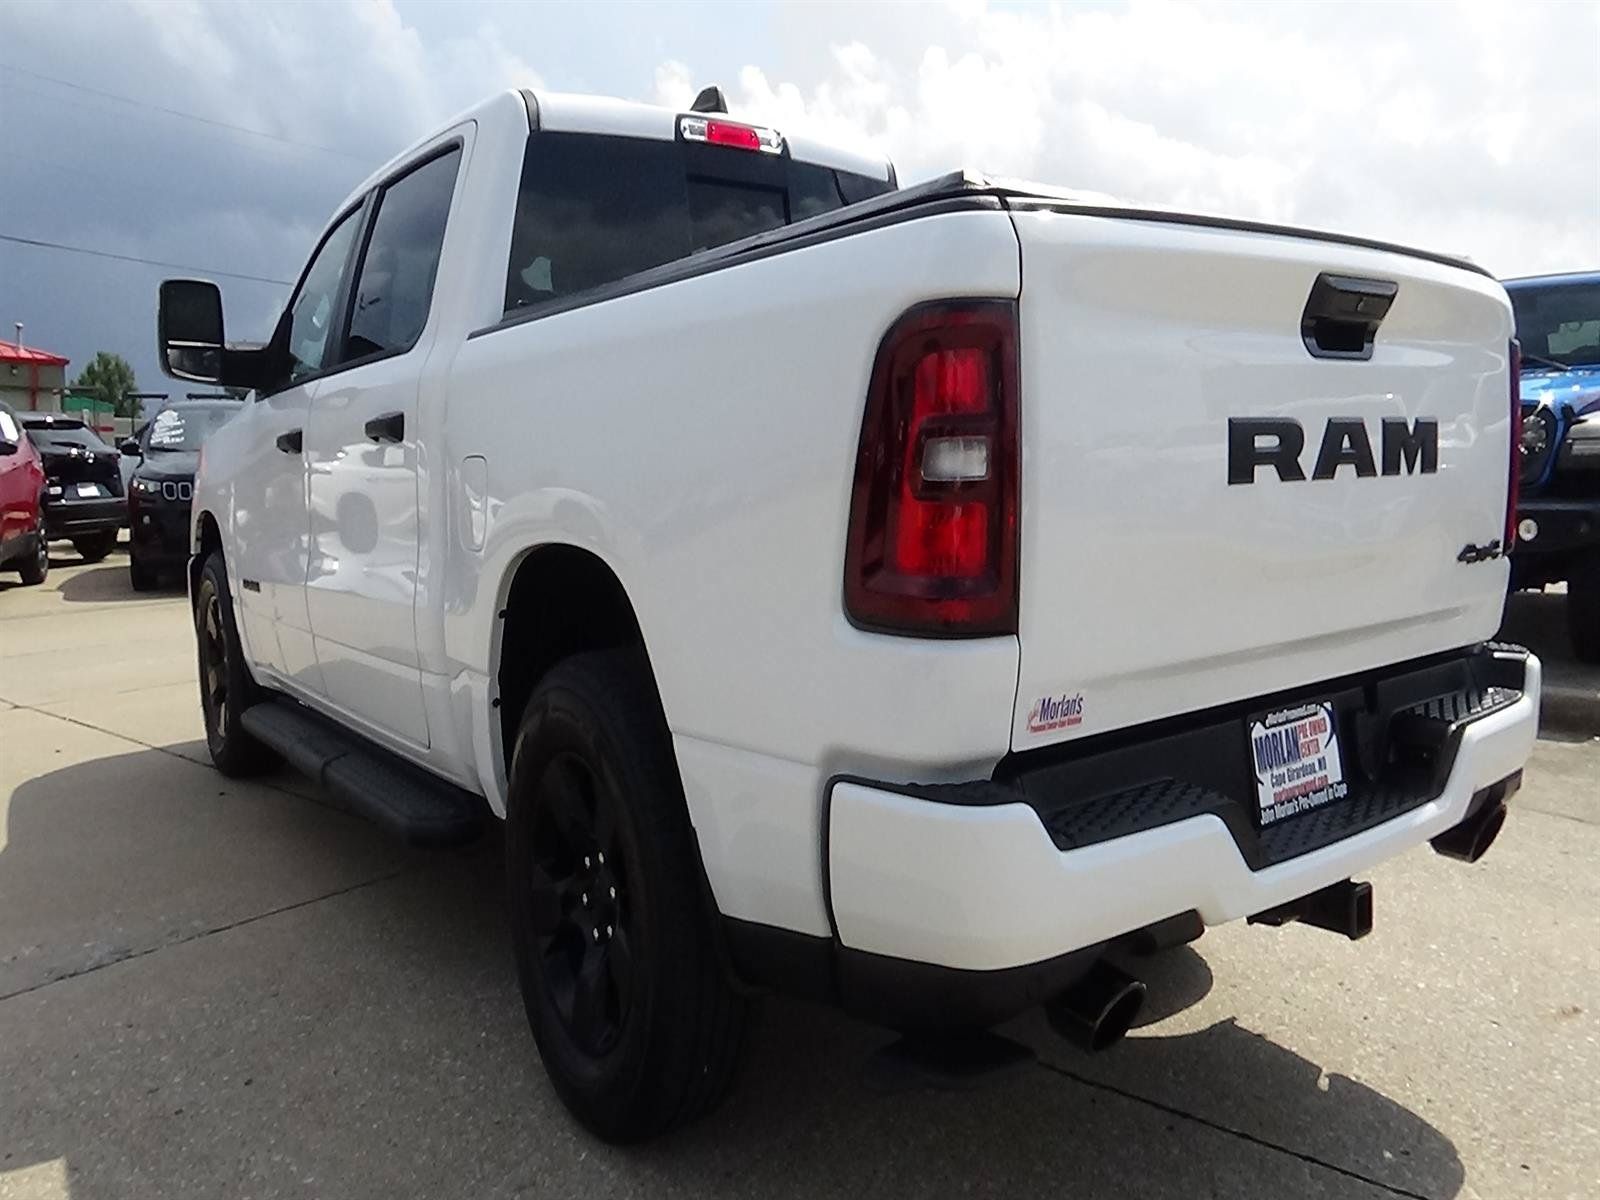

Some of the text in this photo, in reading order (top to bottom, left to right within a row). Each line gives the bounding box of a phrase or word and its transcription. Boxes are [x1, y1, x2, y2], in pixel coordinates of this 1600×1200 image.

[1227, 416, 1439, 486] RAM
[1039, 692, 1083, 722] Morlan's
[1254, 725, 1301, 774] MORLAN
